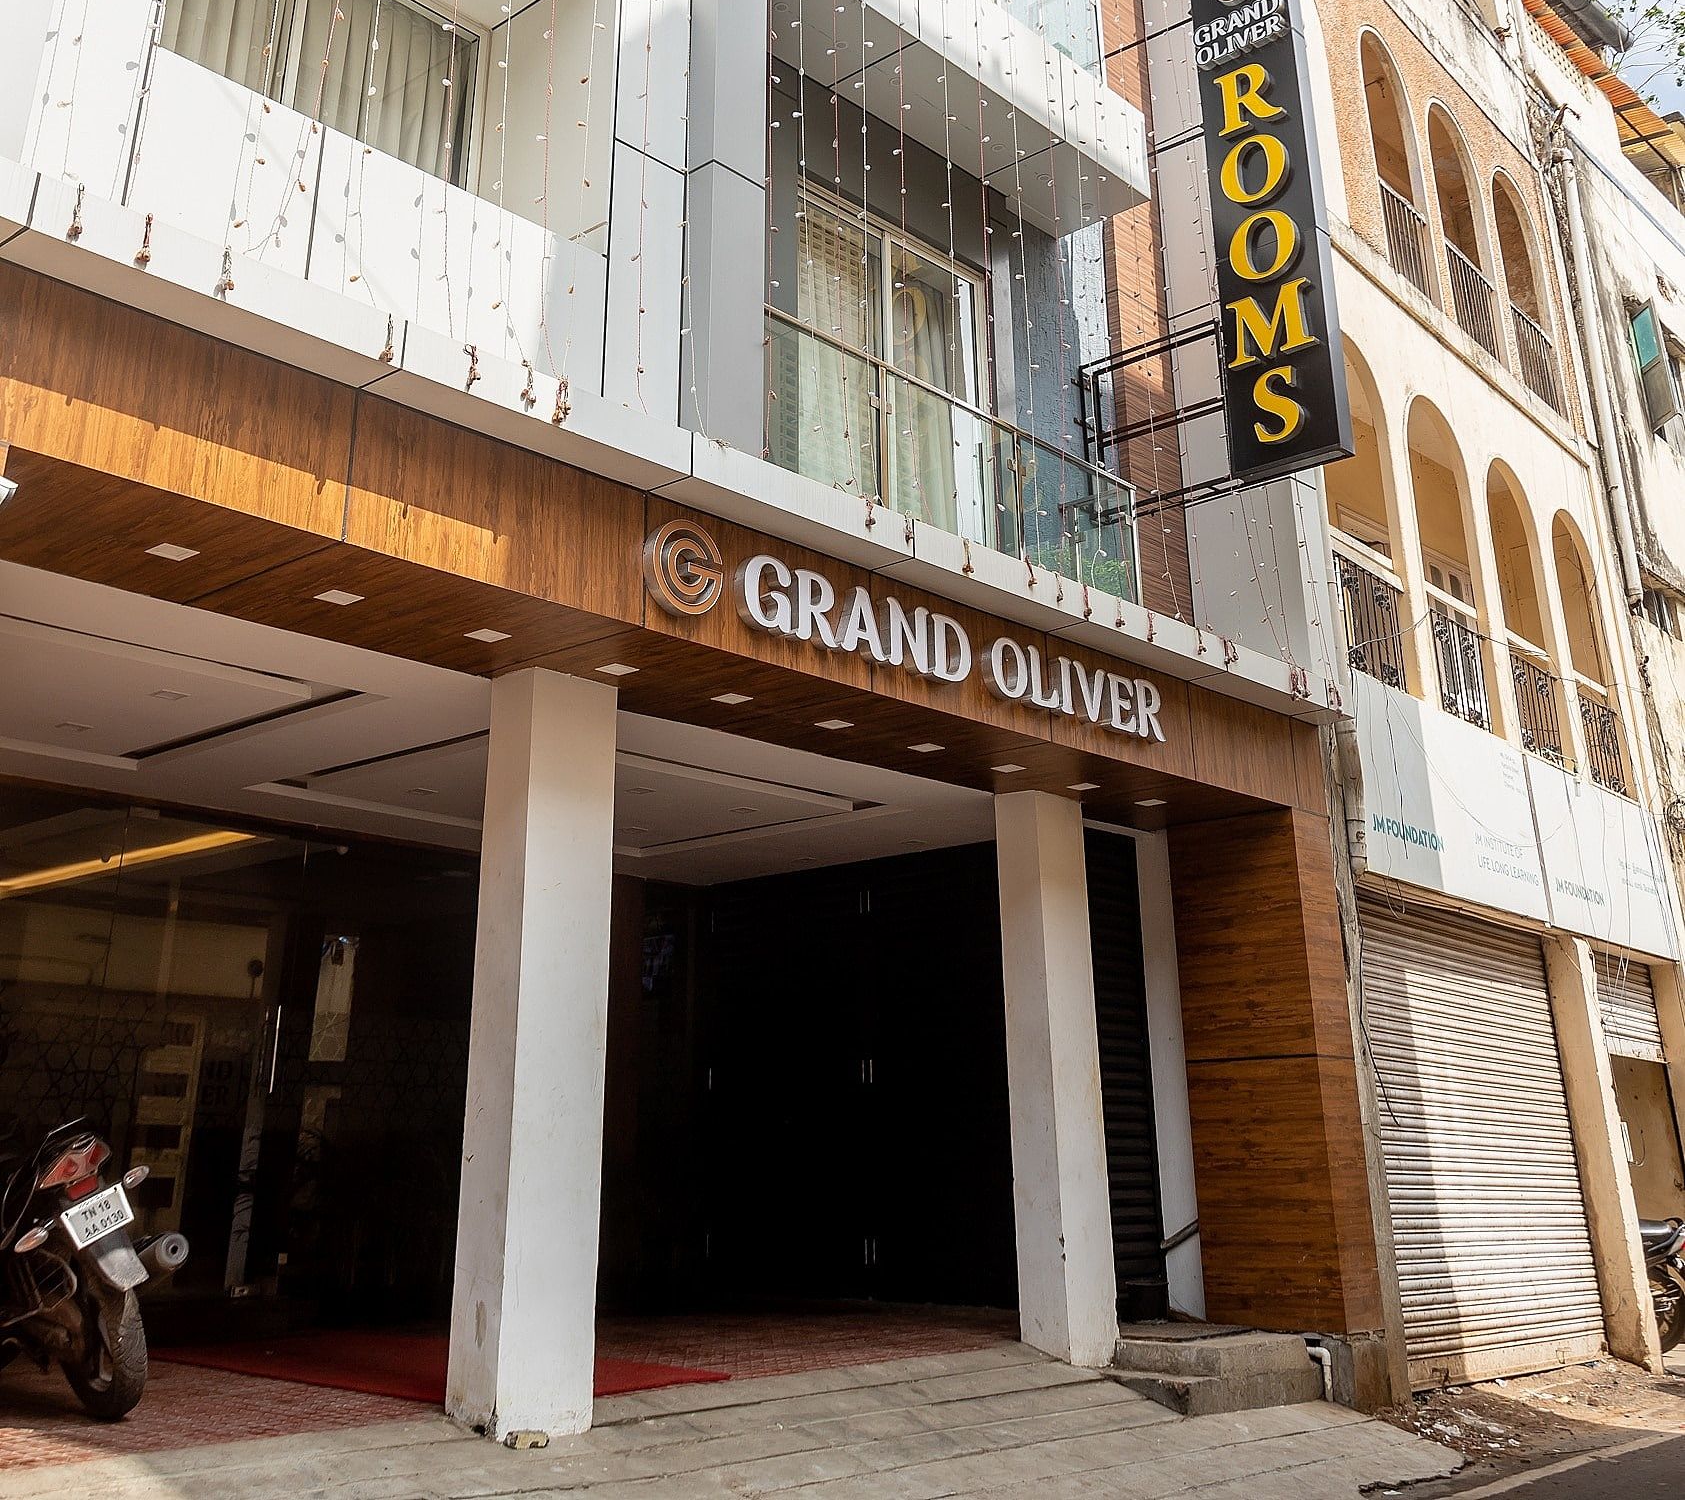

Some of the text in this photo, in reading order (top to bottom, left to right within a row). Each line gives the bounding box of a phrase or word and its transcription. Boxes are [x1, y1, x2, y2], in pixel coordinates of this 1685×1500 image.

[1196, 14, 1282, 65] OLIVER
[1213, 62, 1317, 443] ROOMS
[743, 553, 972, 683] GRAND
[991, 636, 1167, 743] OLIVER
[1372, 813, 1445, 853] JM FOUNDATION
[1565, 880, 1606, 907] FOUNDATION
[81, 1207, 97, 1221] TN
